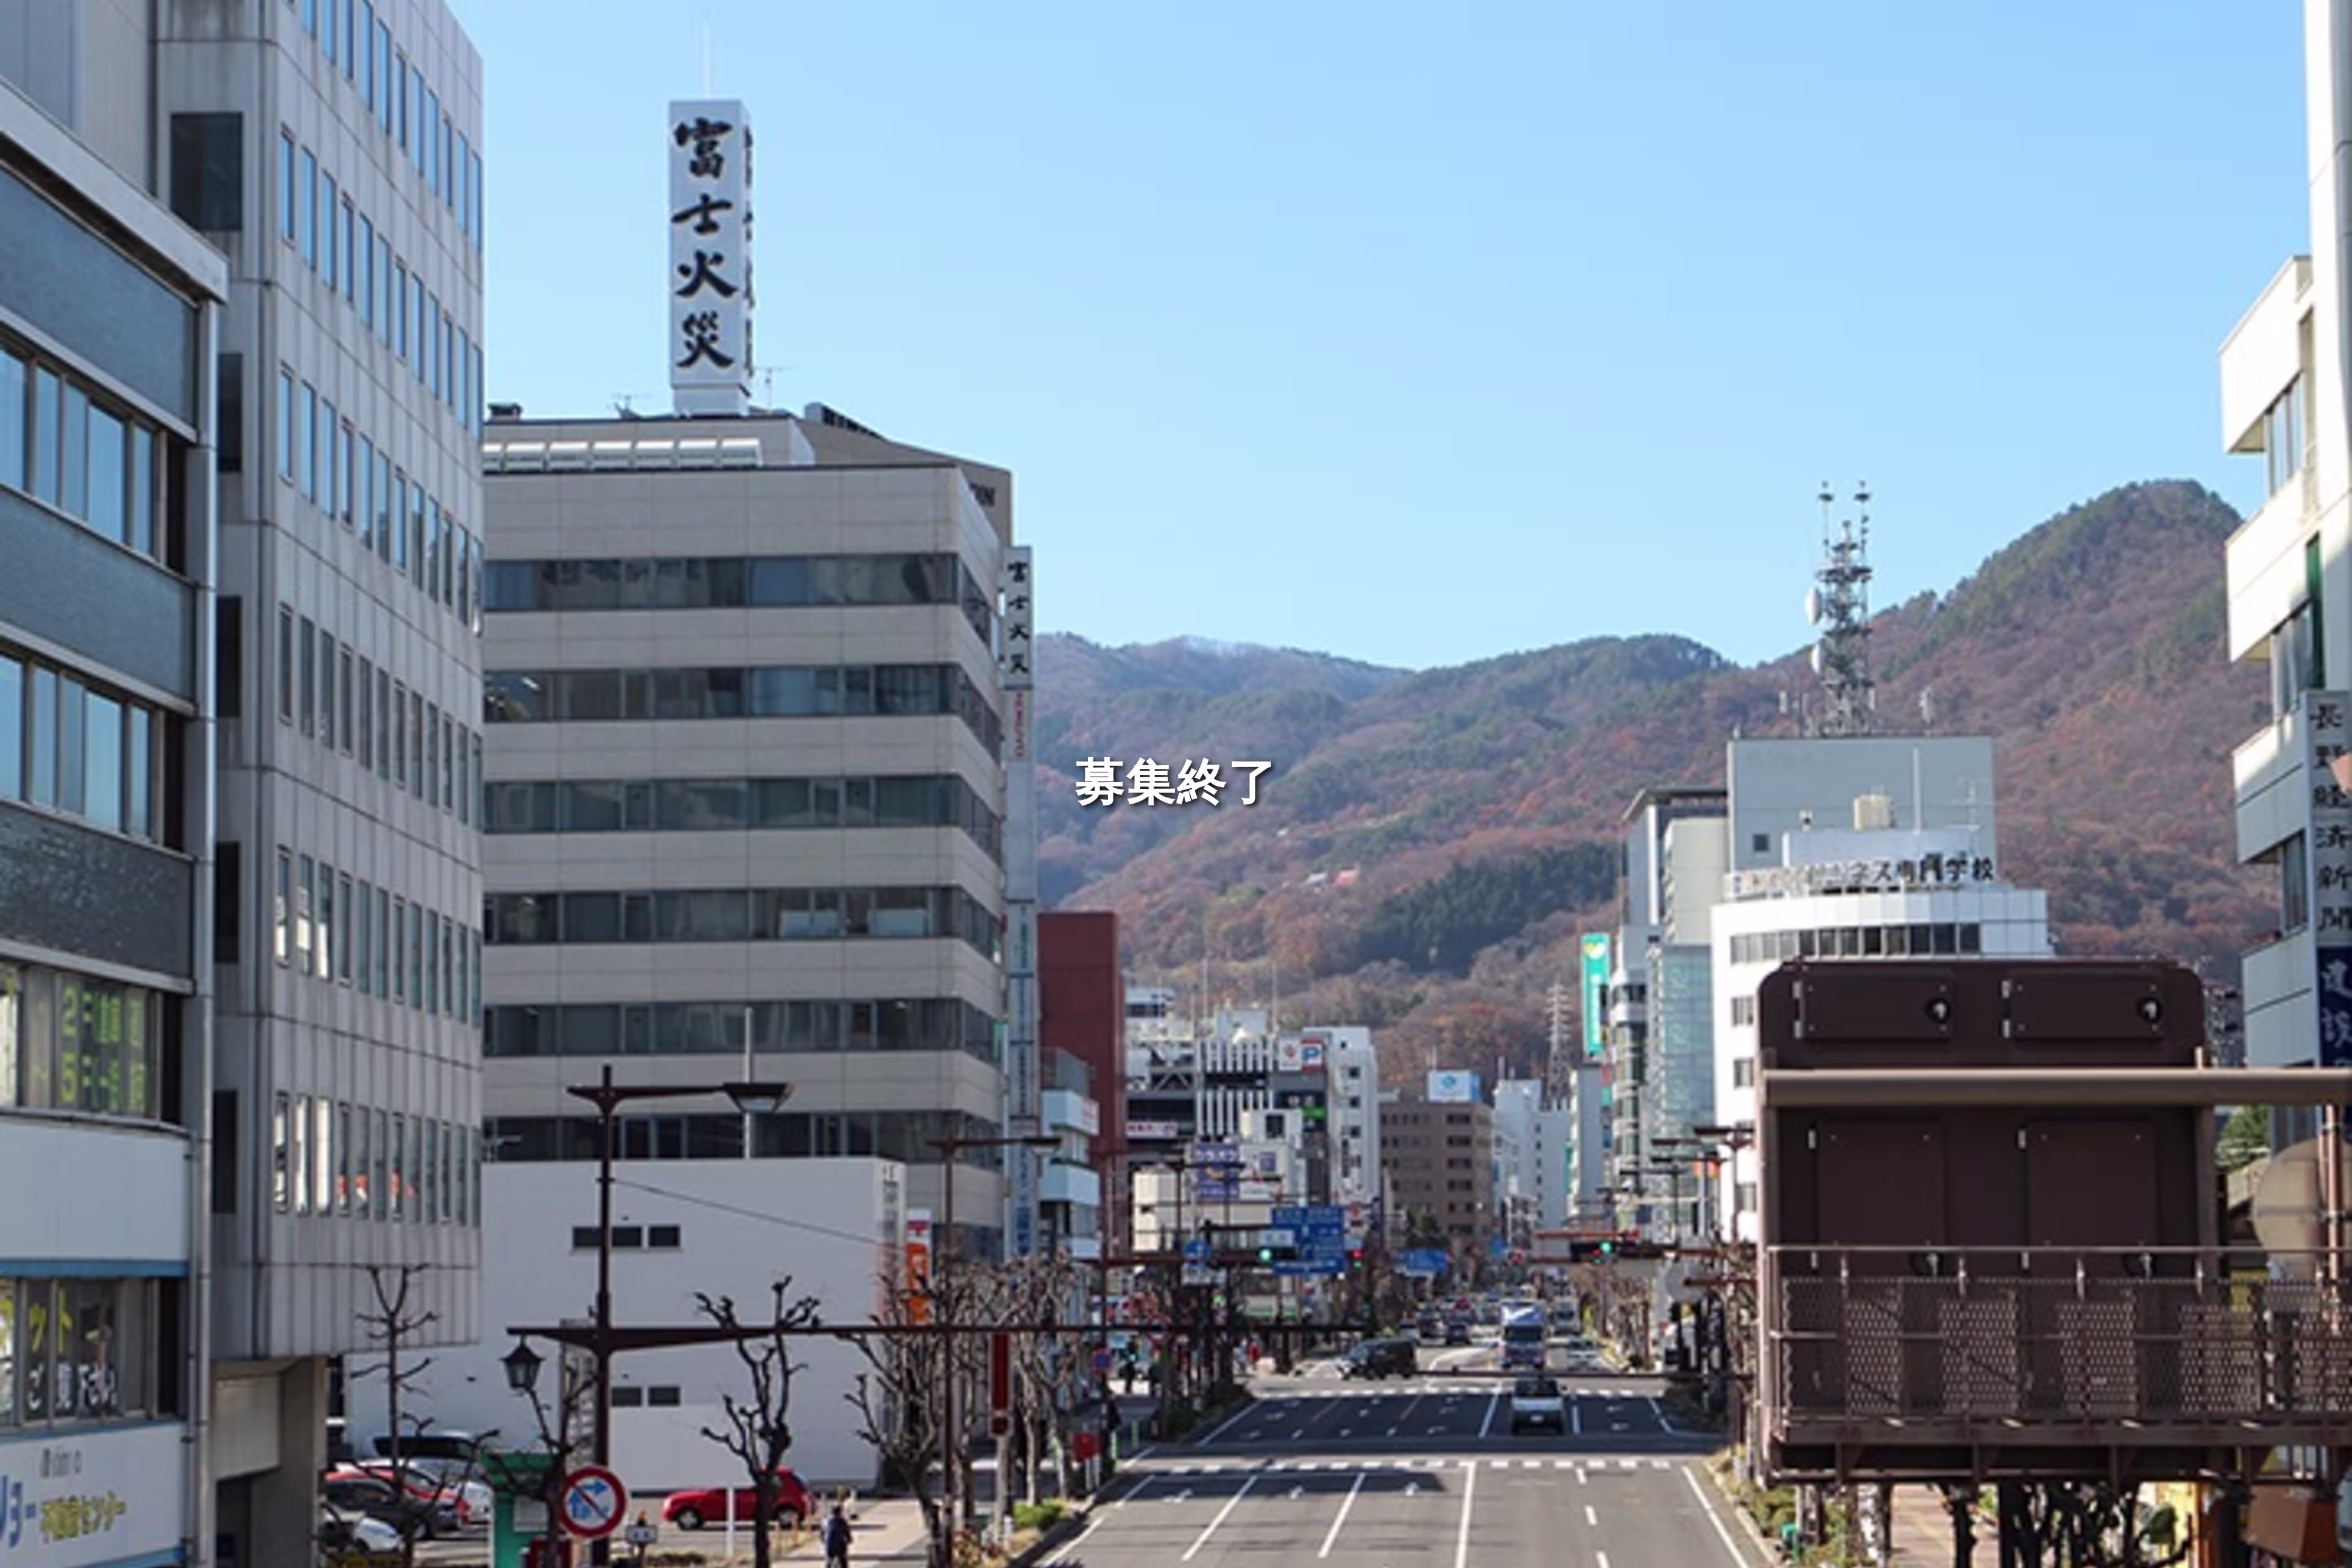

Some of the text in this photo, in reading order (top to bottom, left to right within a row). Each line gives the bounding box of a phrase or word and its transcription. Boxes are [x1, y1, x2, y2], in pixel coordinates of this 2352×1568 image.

[671, 117, 739, 368] 富士火災
[1302, 1046, 1320, 1061] P
